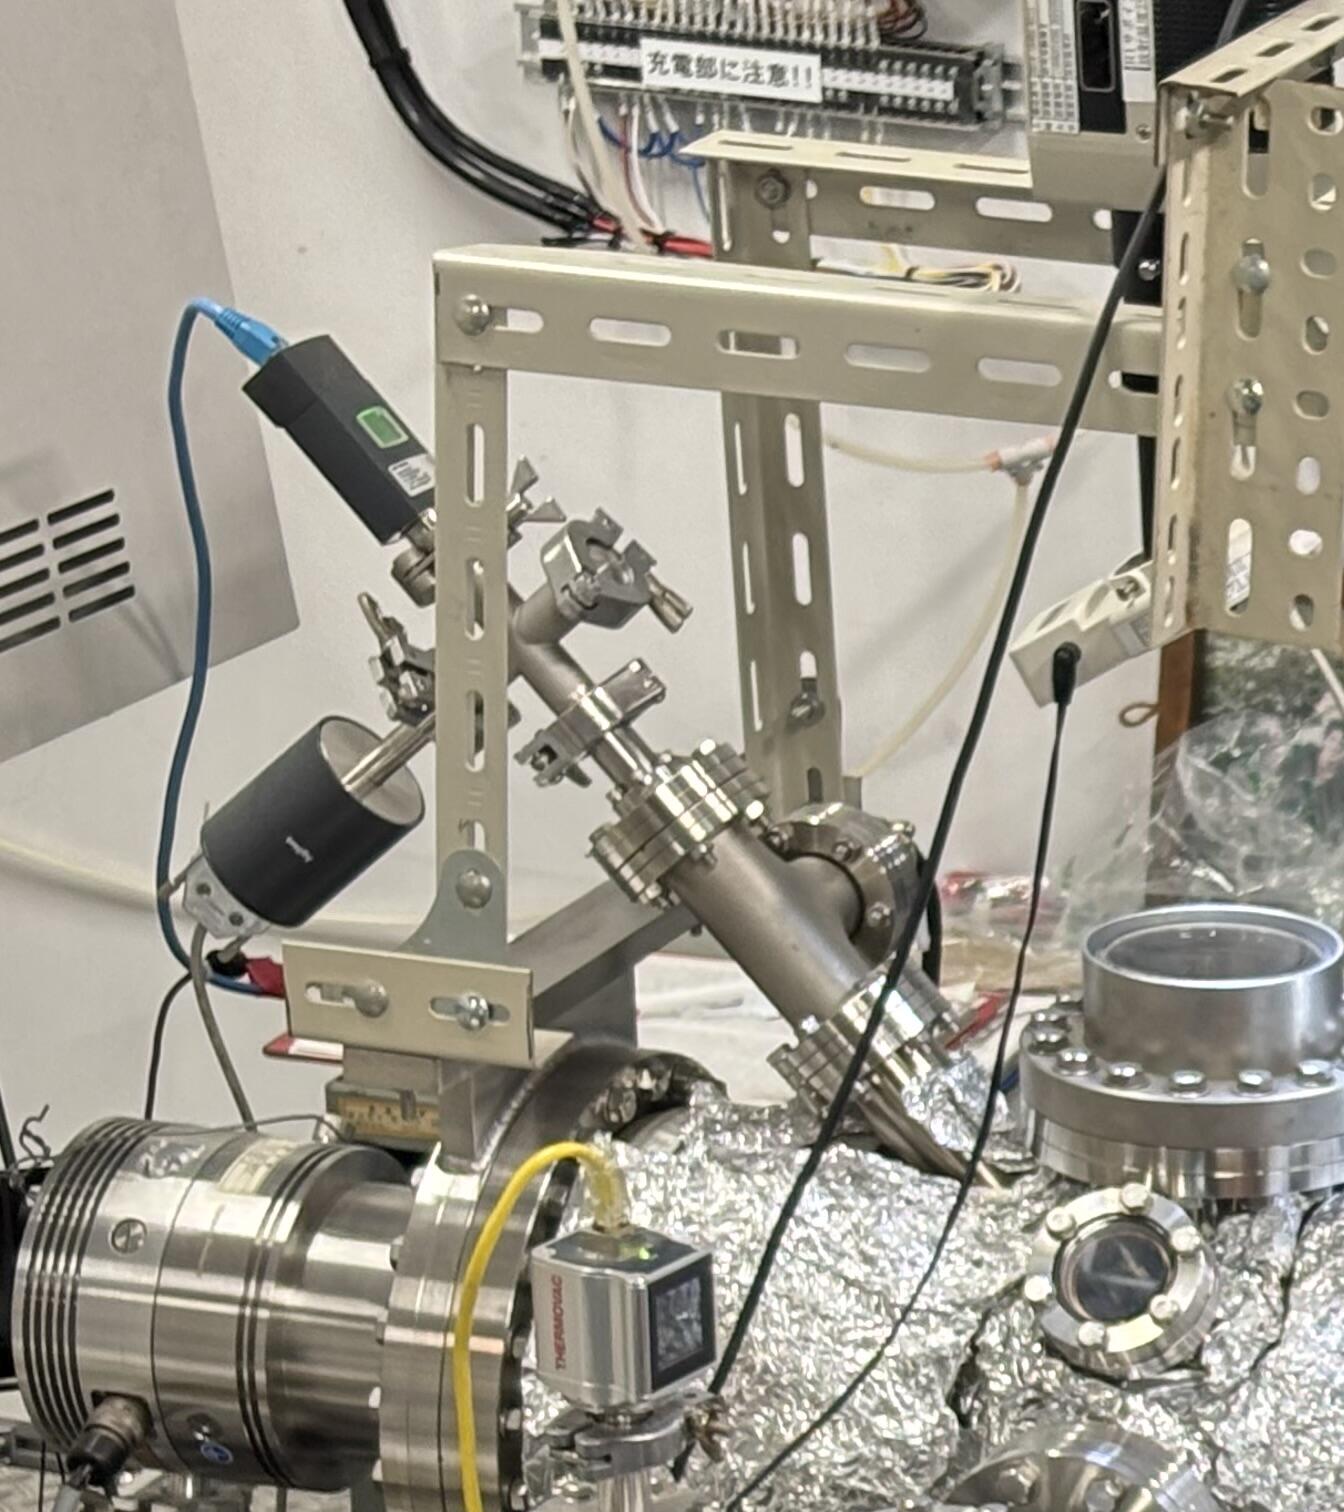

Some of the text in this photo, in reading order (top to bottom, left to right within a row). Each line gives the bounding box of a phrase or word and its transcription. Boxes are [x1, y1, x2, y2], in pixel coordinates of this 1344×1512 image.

[647, 50, 813, 89] 充電部に注意!!
[552, 1274, 566, 1370] THERMOVAC
